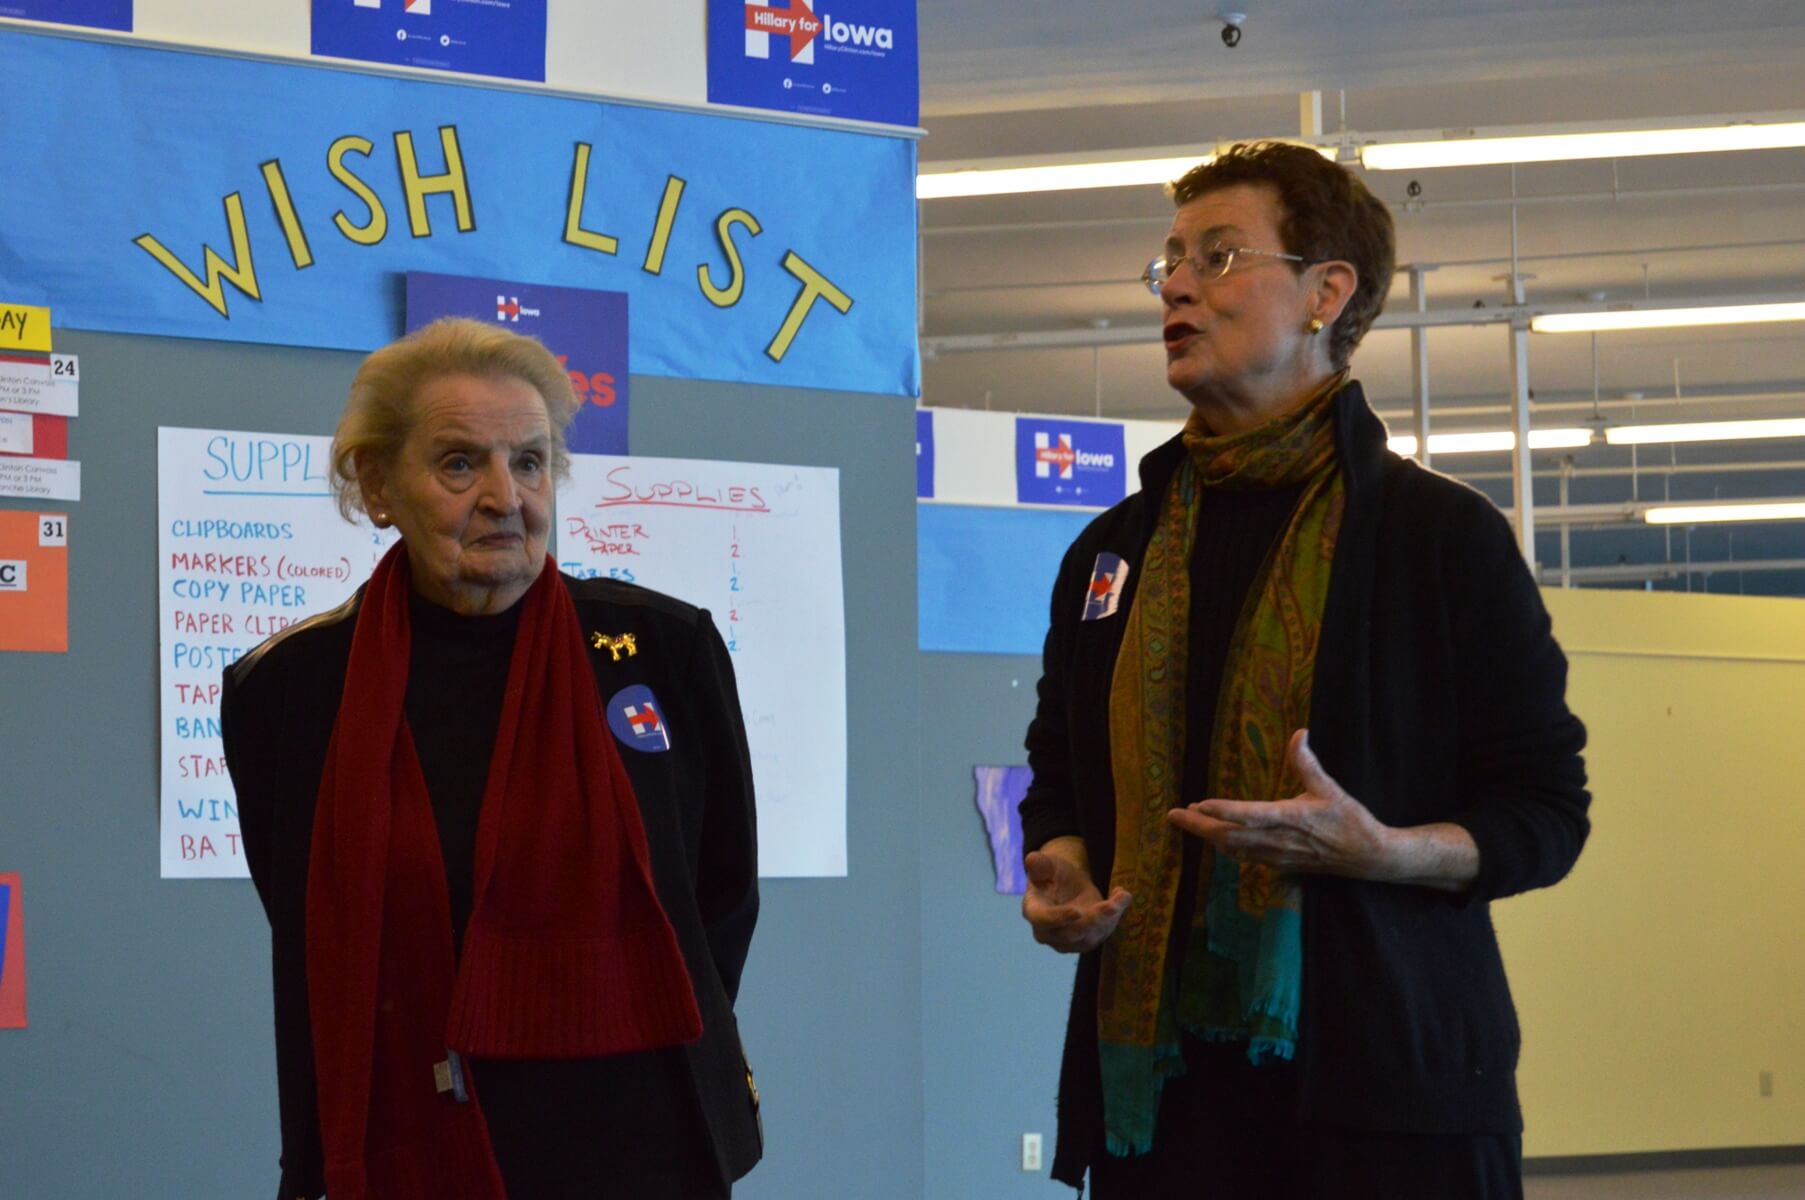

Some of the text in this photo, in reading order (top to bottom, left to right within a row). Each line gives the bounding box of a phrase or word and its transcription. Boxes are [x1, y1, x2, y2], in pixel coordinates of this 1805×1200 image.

[754, 12, 893, 49] Hillary for Iowa
[132, 124, 855, 363] WISH LIST
[0, 310, 28, 341] AY
[54, 360, 75, 376] 24
[556, 354, 616, 407] es
[203, 436, 327, 482] SUPPL
[1076, 449, 1114, 467] Iowa
[602, 466, 766, 508] SUPPLIES
[43, 521, 64, 537] 31
[171, 519, 294, 540] CLIPBOARDS
[566, 517, 649, 542] PRINTER
[588, 540, 640, 556] PAPER
[172, 553, 351, 583] MARKERS (COLORED)
[172, 579, 306, 607] COPY PAPER
[174, 611, 234, 634] PAPER
[174, 643, 250, 669] POSTE
[174, 684, 220, 704] TAP
[175, 716, 223, 739] BAN
[178, 799, 239, 821] WIN
